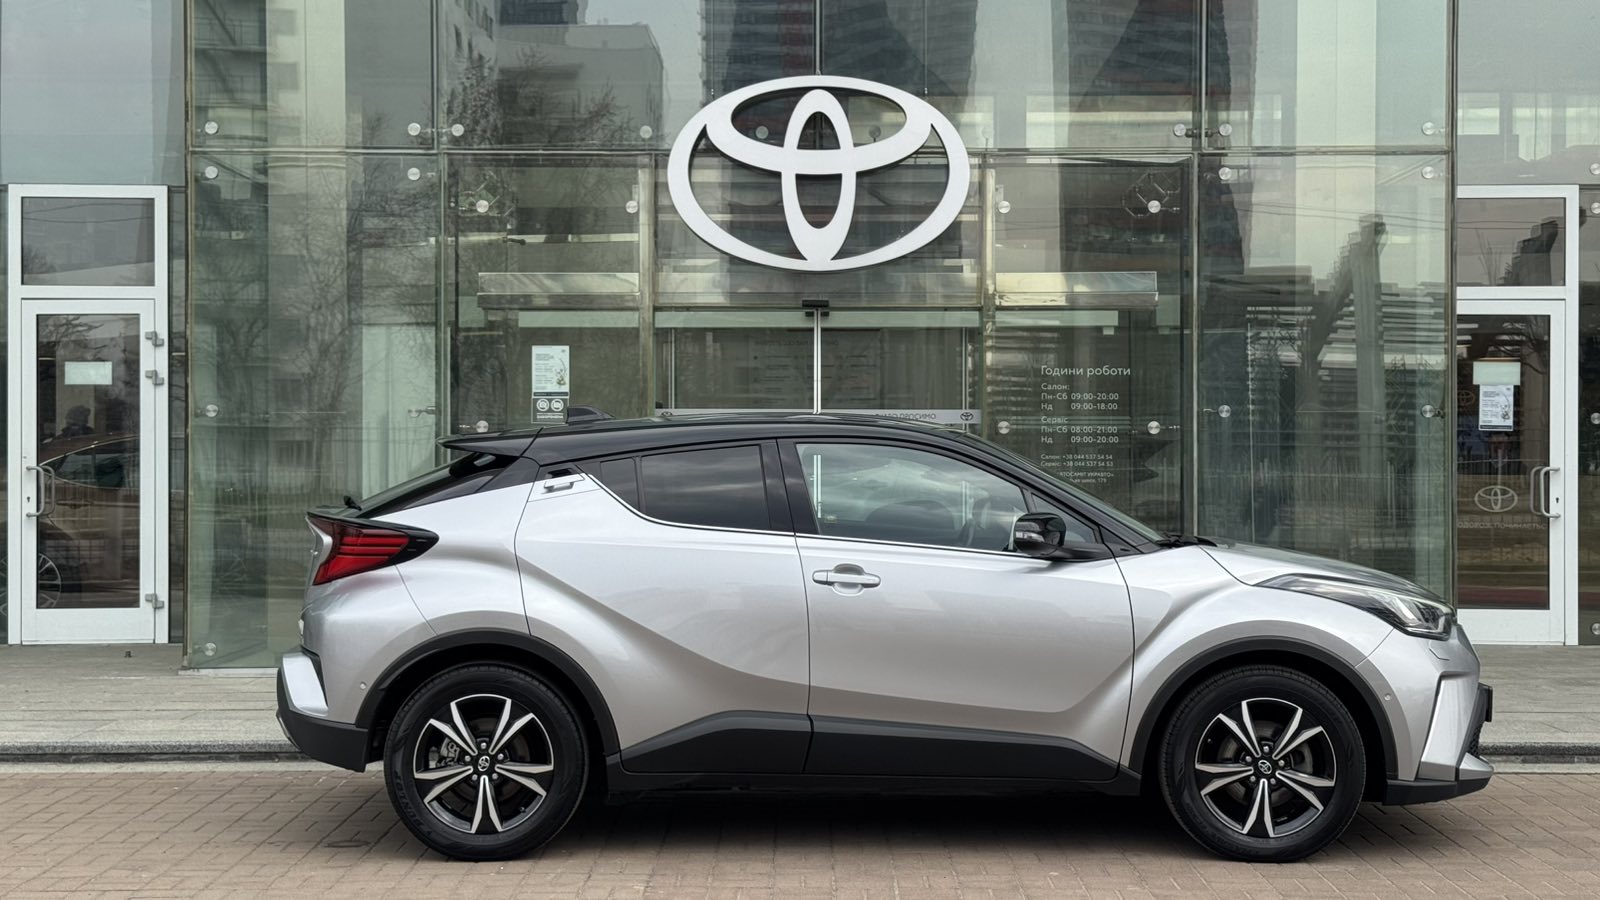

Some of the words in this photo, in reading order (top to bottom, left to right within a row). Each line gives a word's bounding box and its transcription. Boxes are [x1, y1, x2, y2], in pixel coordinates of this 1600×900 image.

[1041, 365, 1084, 377] Години
[1087, 365, 1131, 378] роботи
[1041, 403, 1053, 411] Нд
[1041, 436, 1053, 444] Нд
